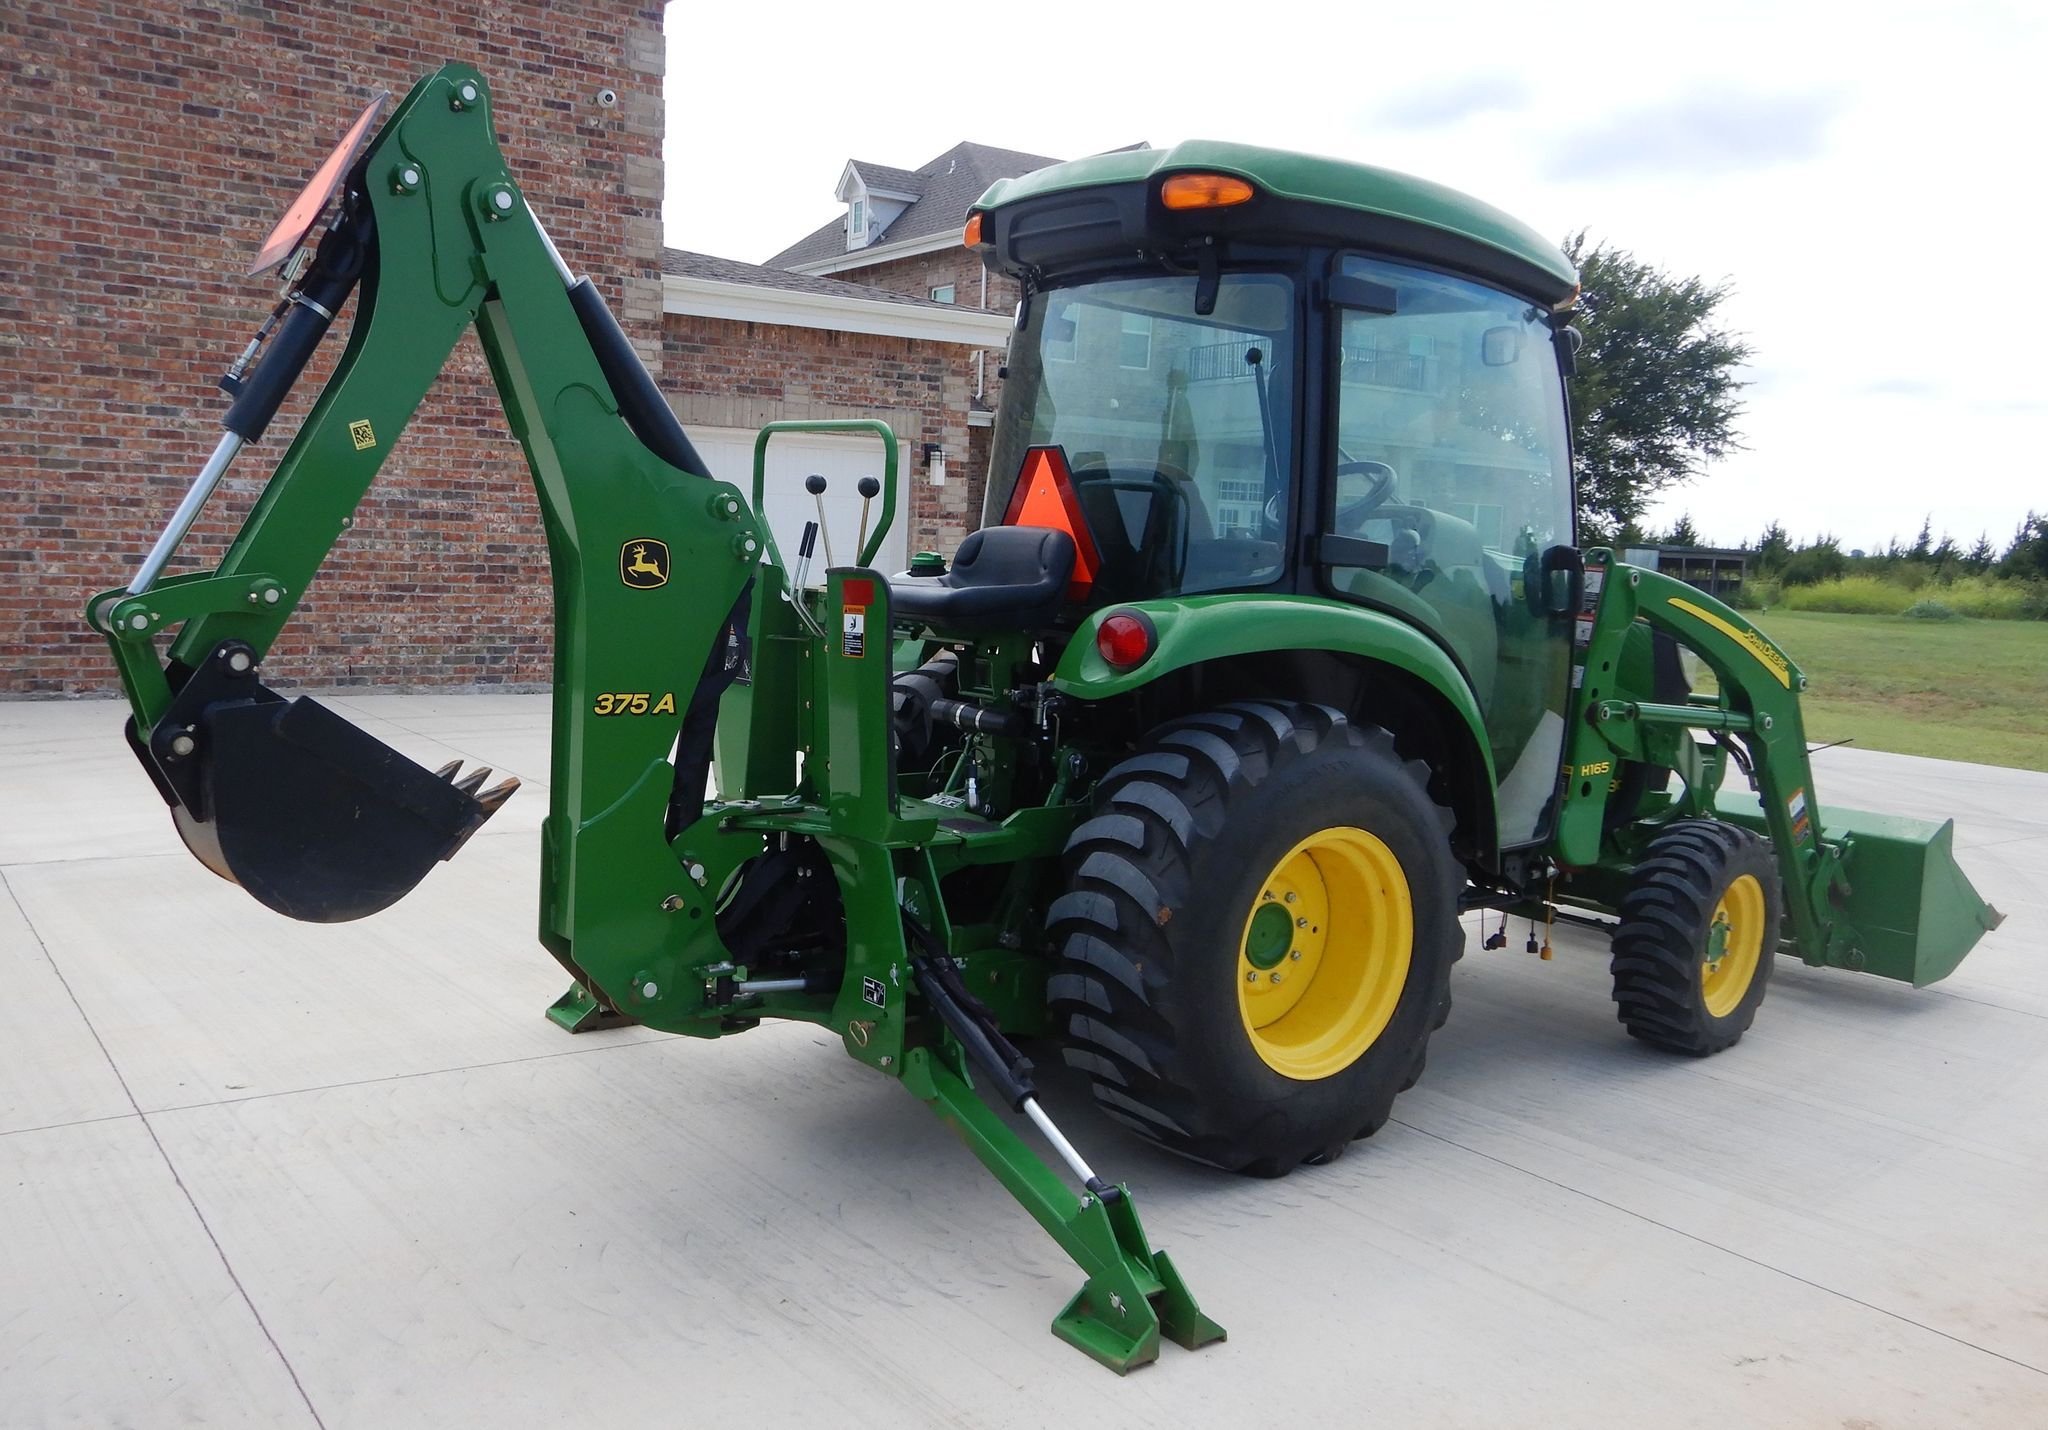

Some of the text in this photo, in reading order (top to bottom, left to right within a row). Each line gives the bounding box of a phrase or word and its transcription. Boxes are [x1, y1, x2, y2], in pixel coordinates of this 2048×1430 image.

[1743, 629, 1788, 673] JOHN DEERE
[593, 692, 676, 715] 375 A
[1581, 761, 1610, 777] H165
